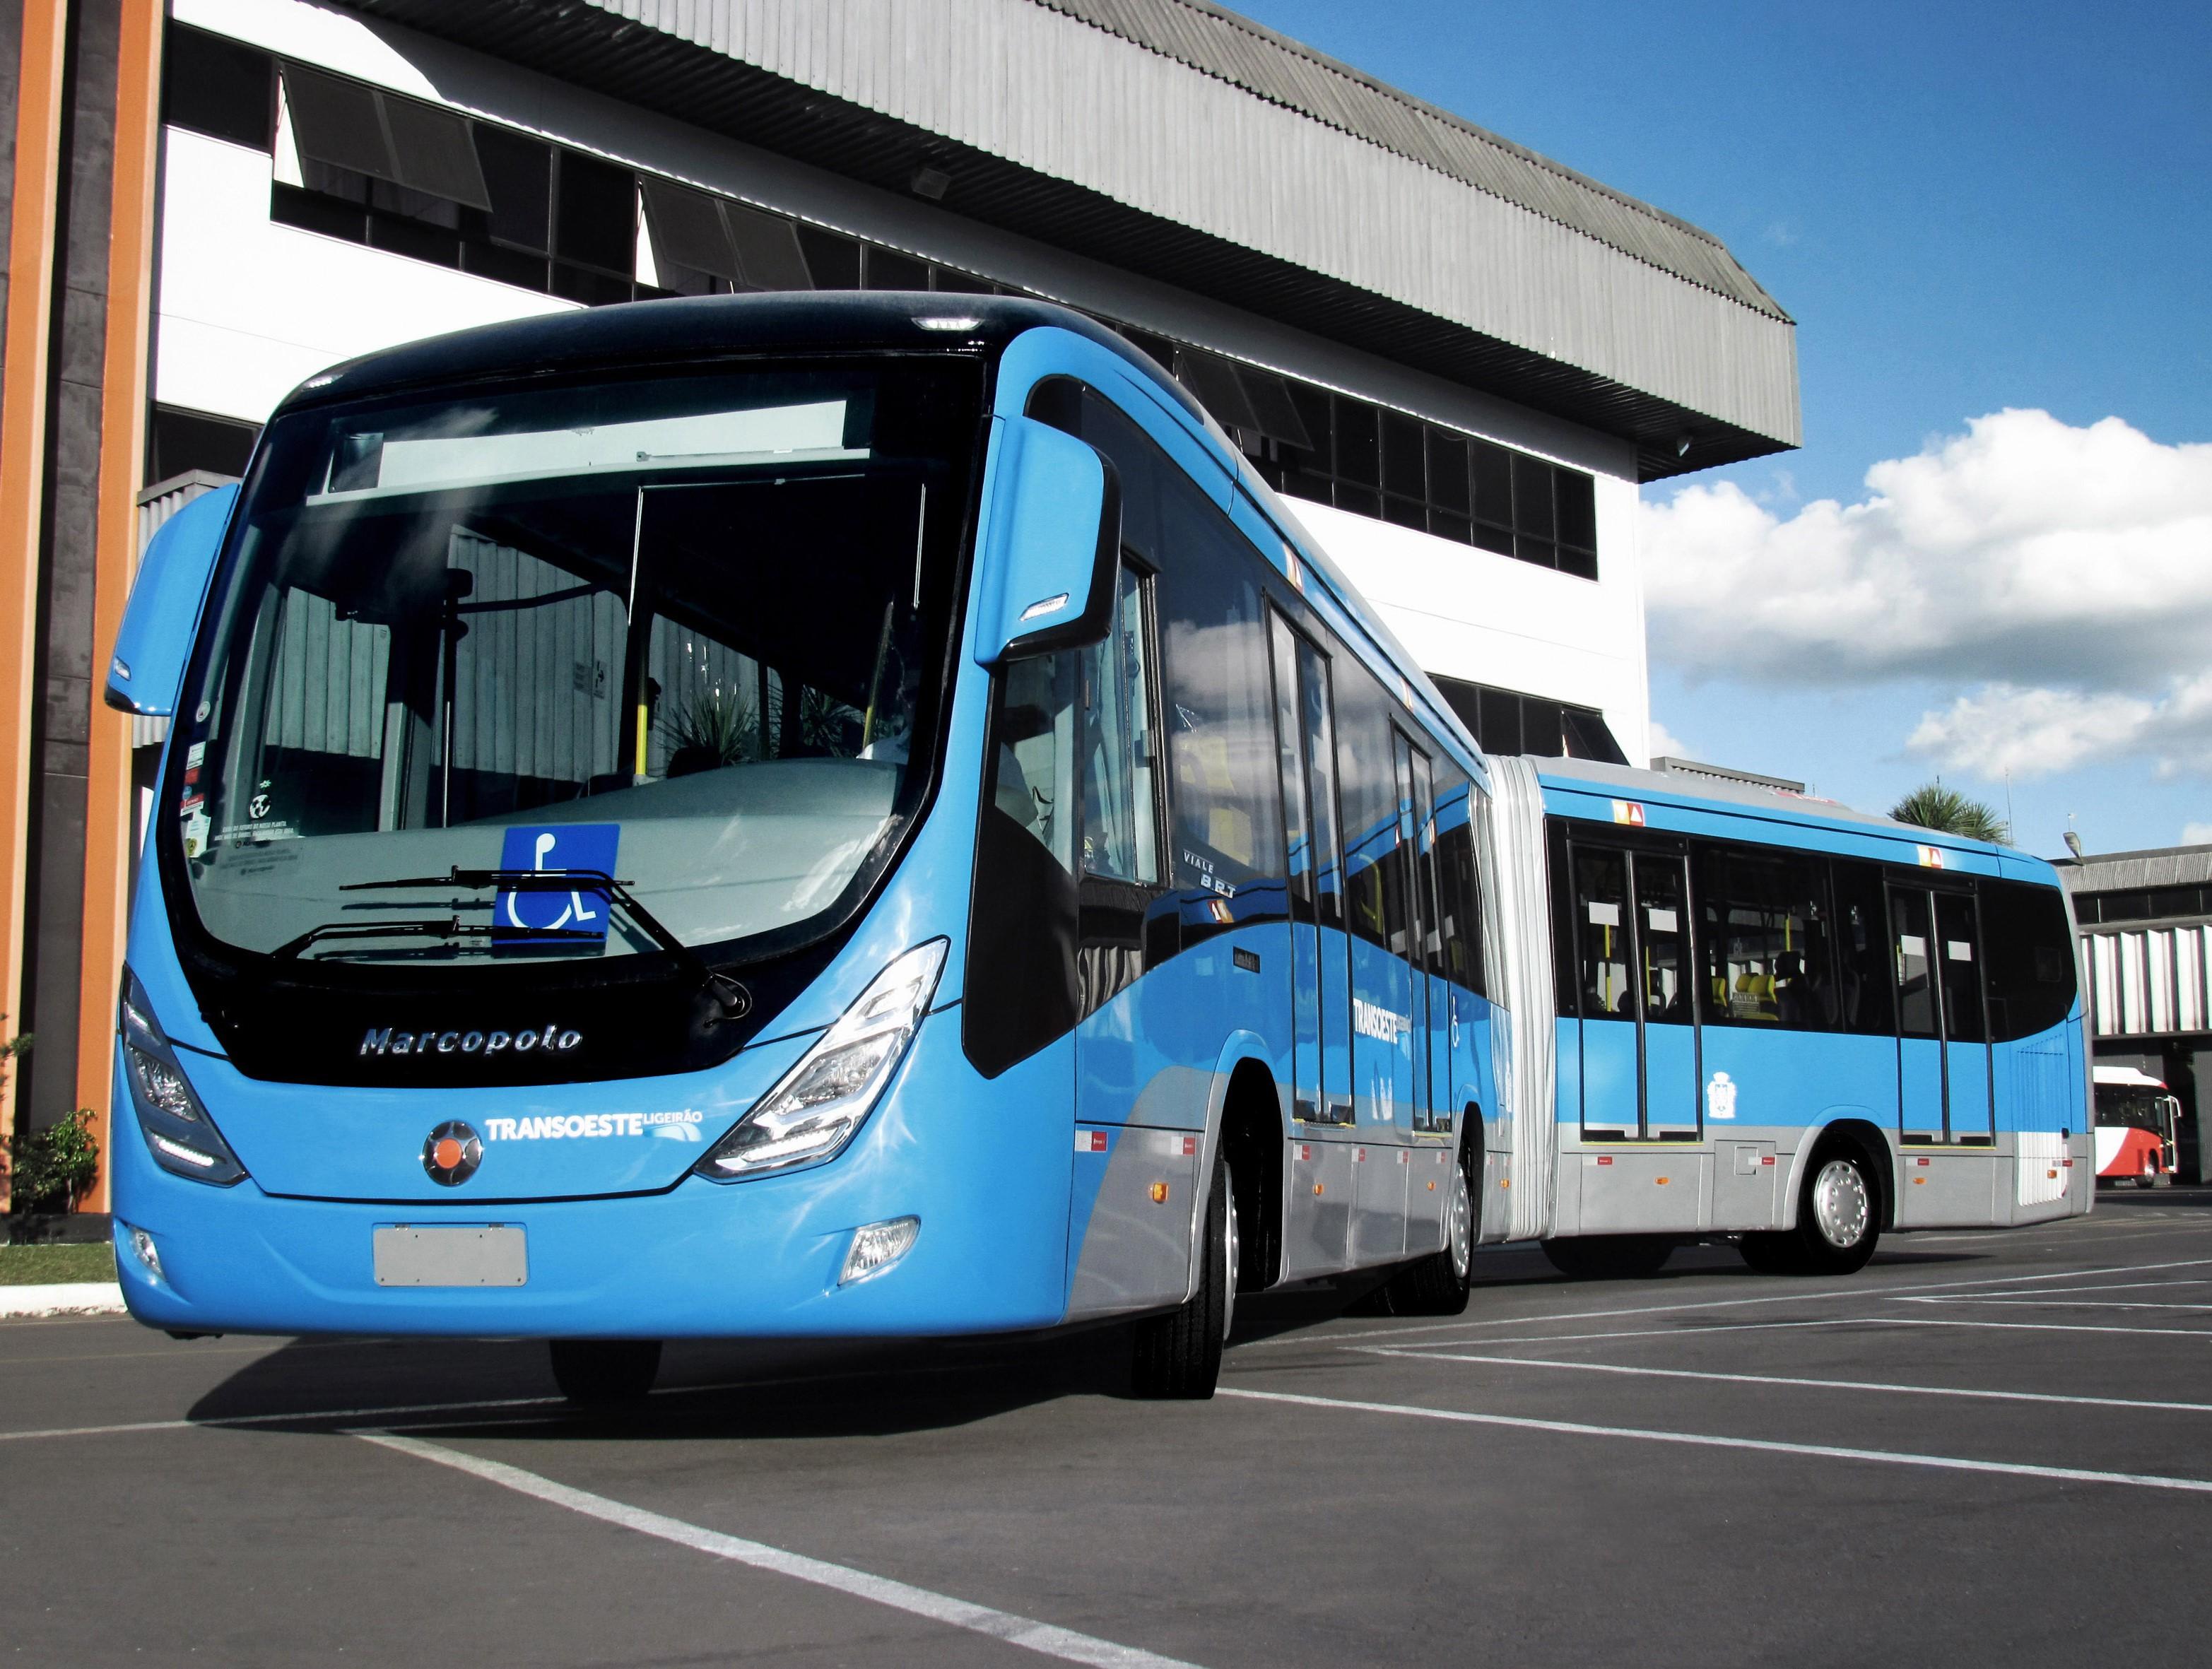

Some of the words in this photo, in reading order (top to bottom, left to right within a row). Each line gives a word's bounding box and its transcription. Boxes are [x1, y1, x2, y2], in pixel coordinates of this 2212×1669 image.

[1184, 851, 1214, 874] VIALE
[1353, 997, 1398, 1045] TRANSOESTE
[360, 1024, 583, 1056] Marcopolo
[485, 1112, 643, 1141] TRANSOESTE
[642, 1108, 703, 1125] LIGEIRÃO
